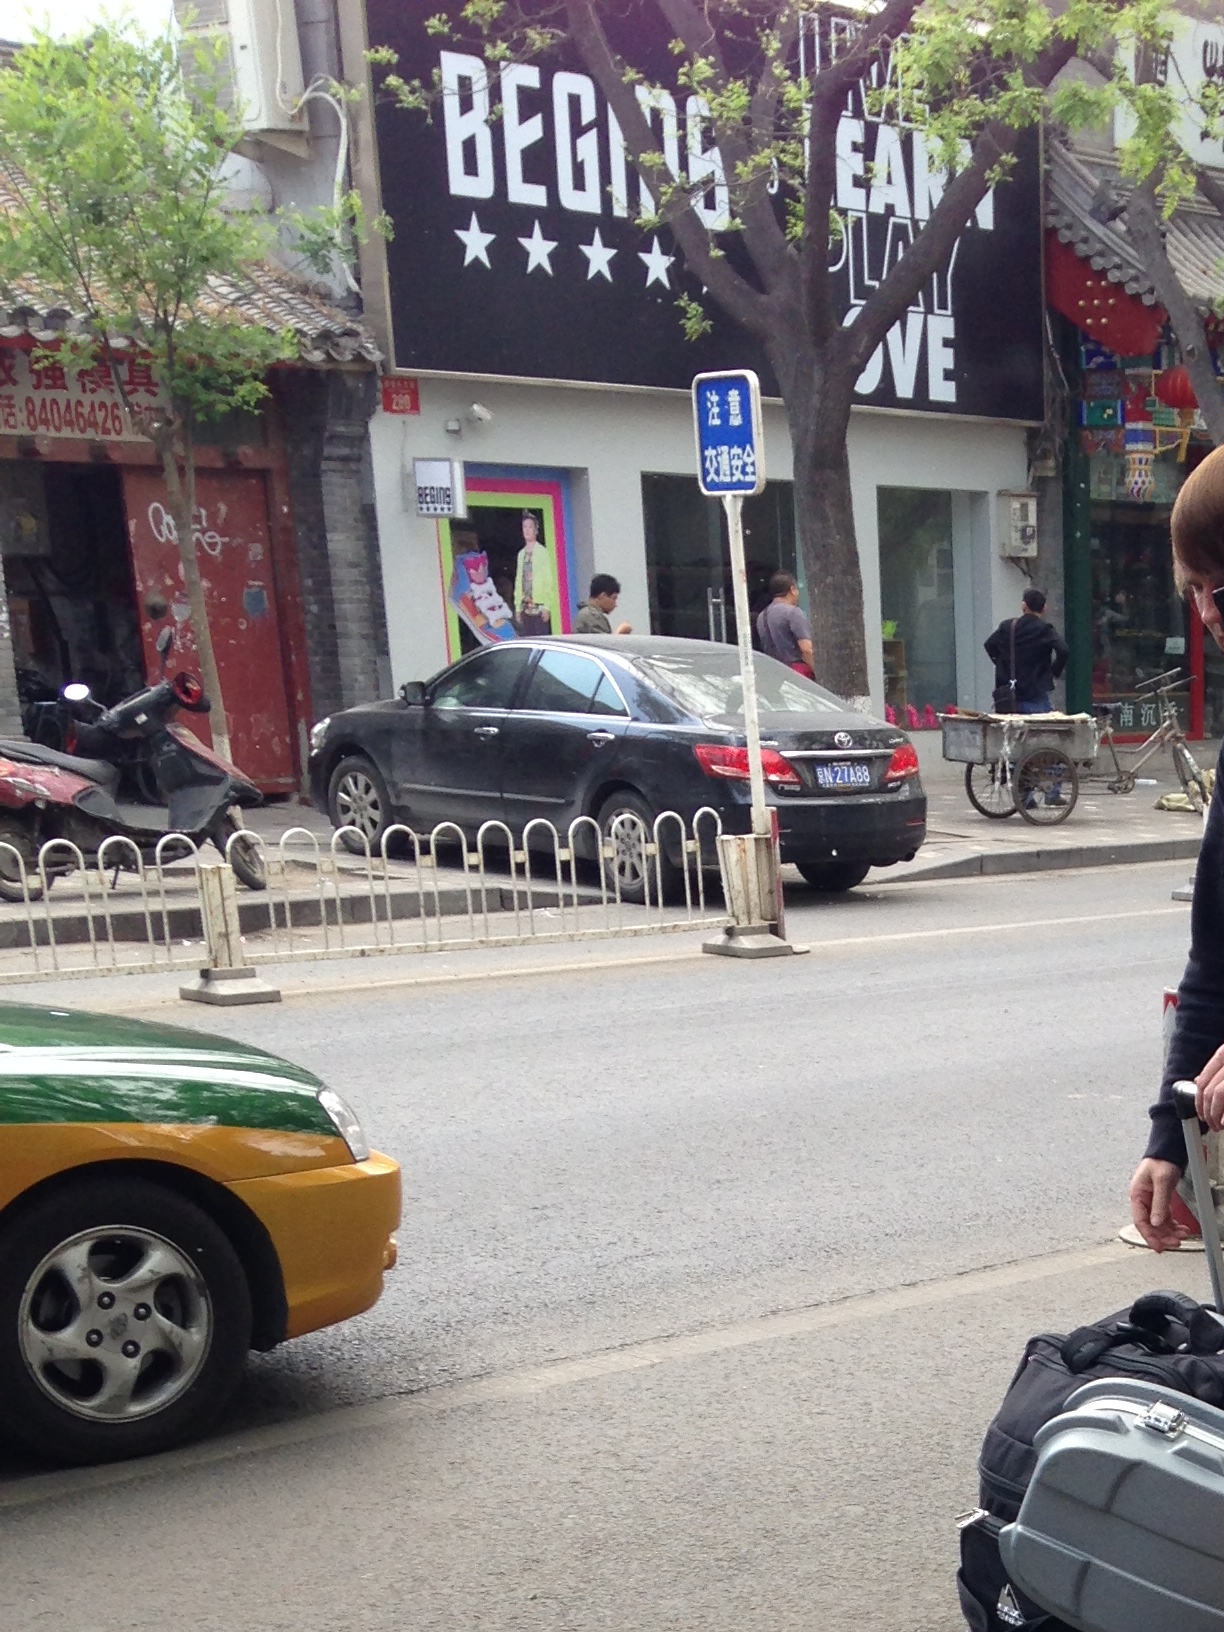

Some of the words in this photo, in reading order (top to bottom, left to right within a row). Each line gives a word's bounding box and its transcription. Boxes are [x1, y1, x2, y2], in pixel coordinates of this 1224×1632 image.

[842, 306, 957, 403] OVE
[707, 389, 743, 426] 注意
[704, 444, 756, 482] 交通安全
[417, 486, 452, 505] BEGINS
